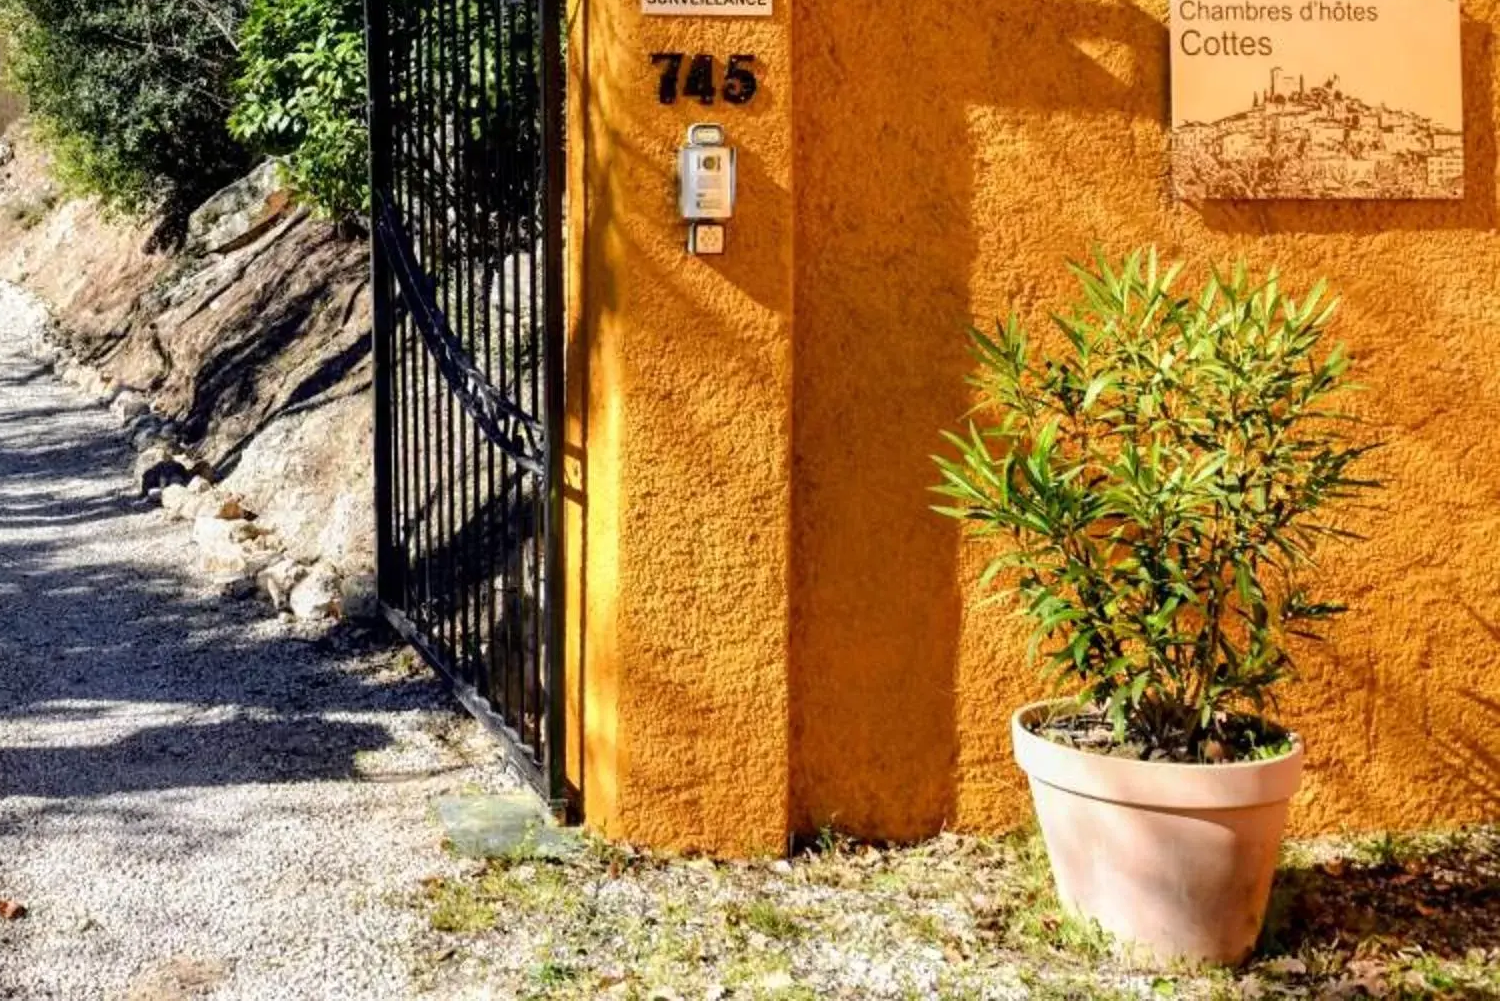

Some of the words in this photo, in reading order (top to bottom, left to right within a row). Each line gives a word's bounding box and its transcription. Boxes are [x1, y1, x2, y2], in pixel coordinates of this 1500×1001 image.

[1179, 0, 1293, 22] Chambres
[1299, 0, 1379, 22] d'hôtes
[1180, 29, 1273, 56] Cottes
[650, 53, 757, 105] 745
